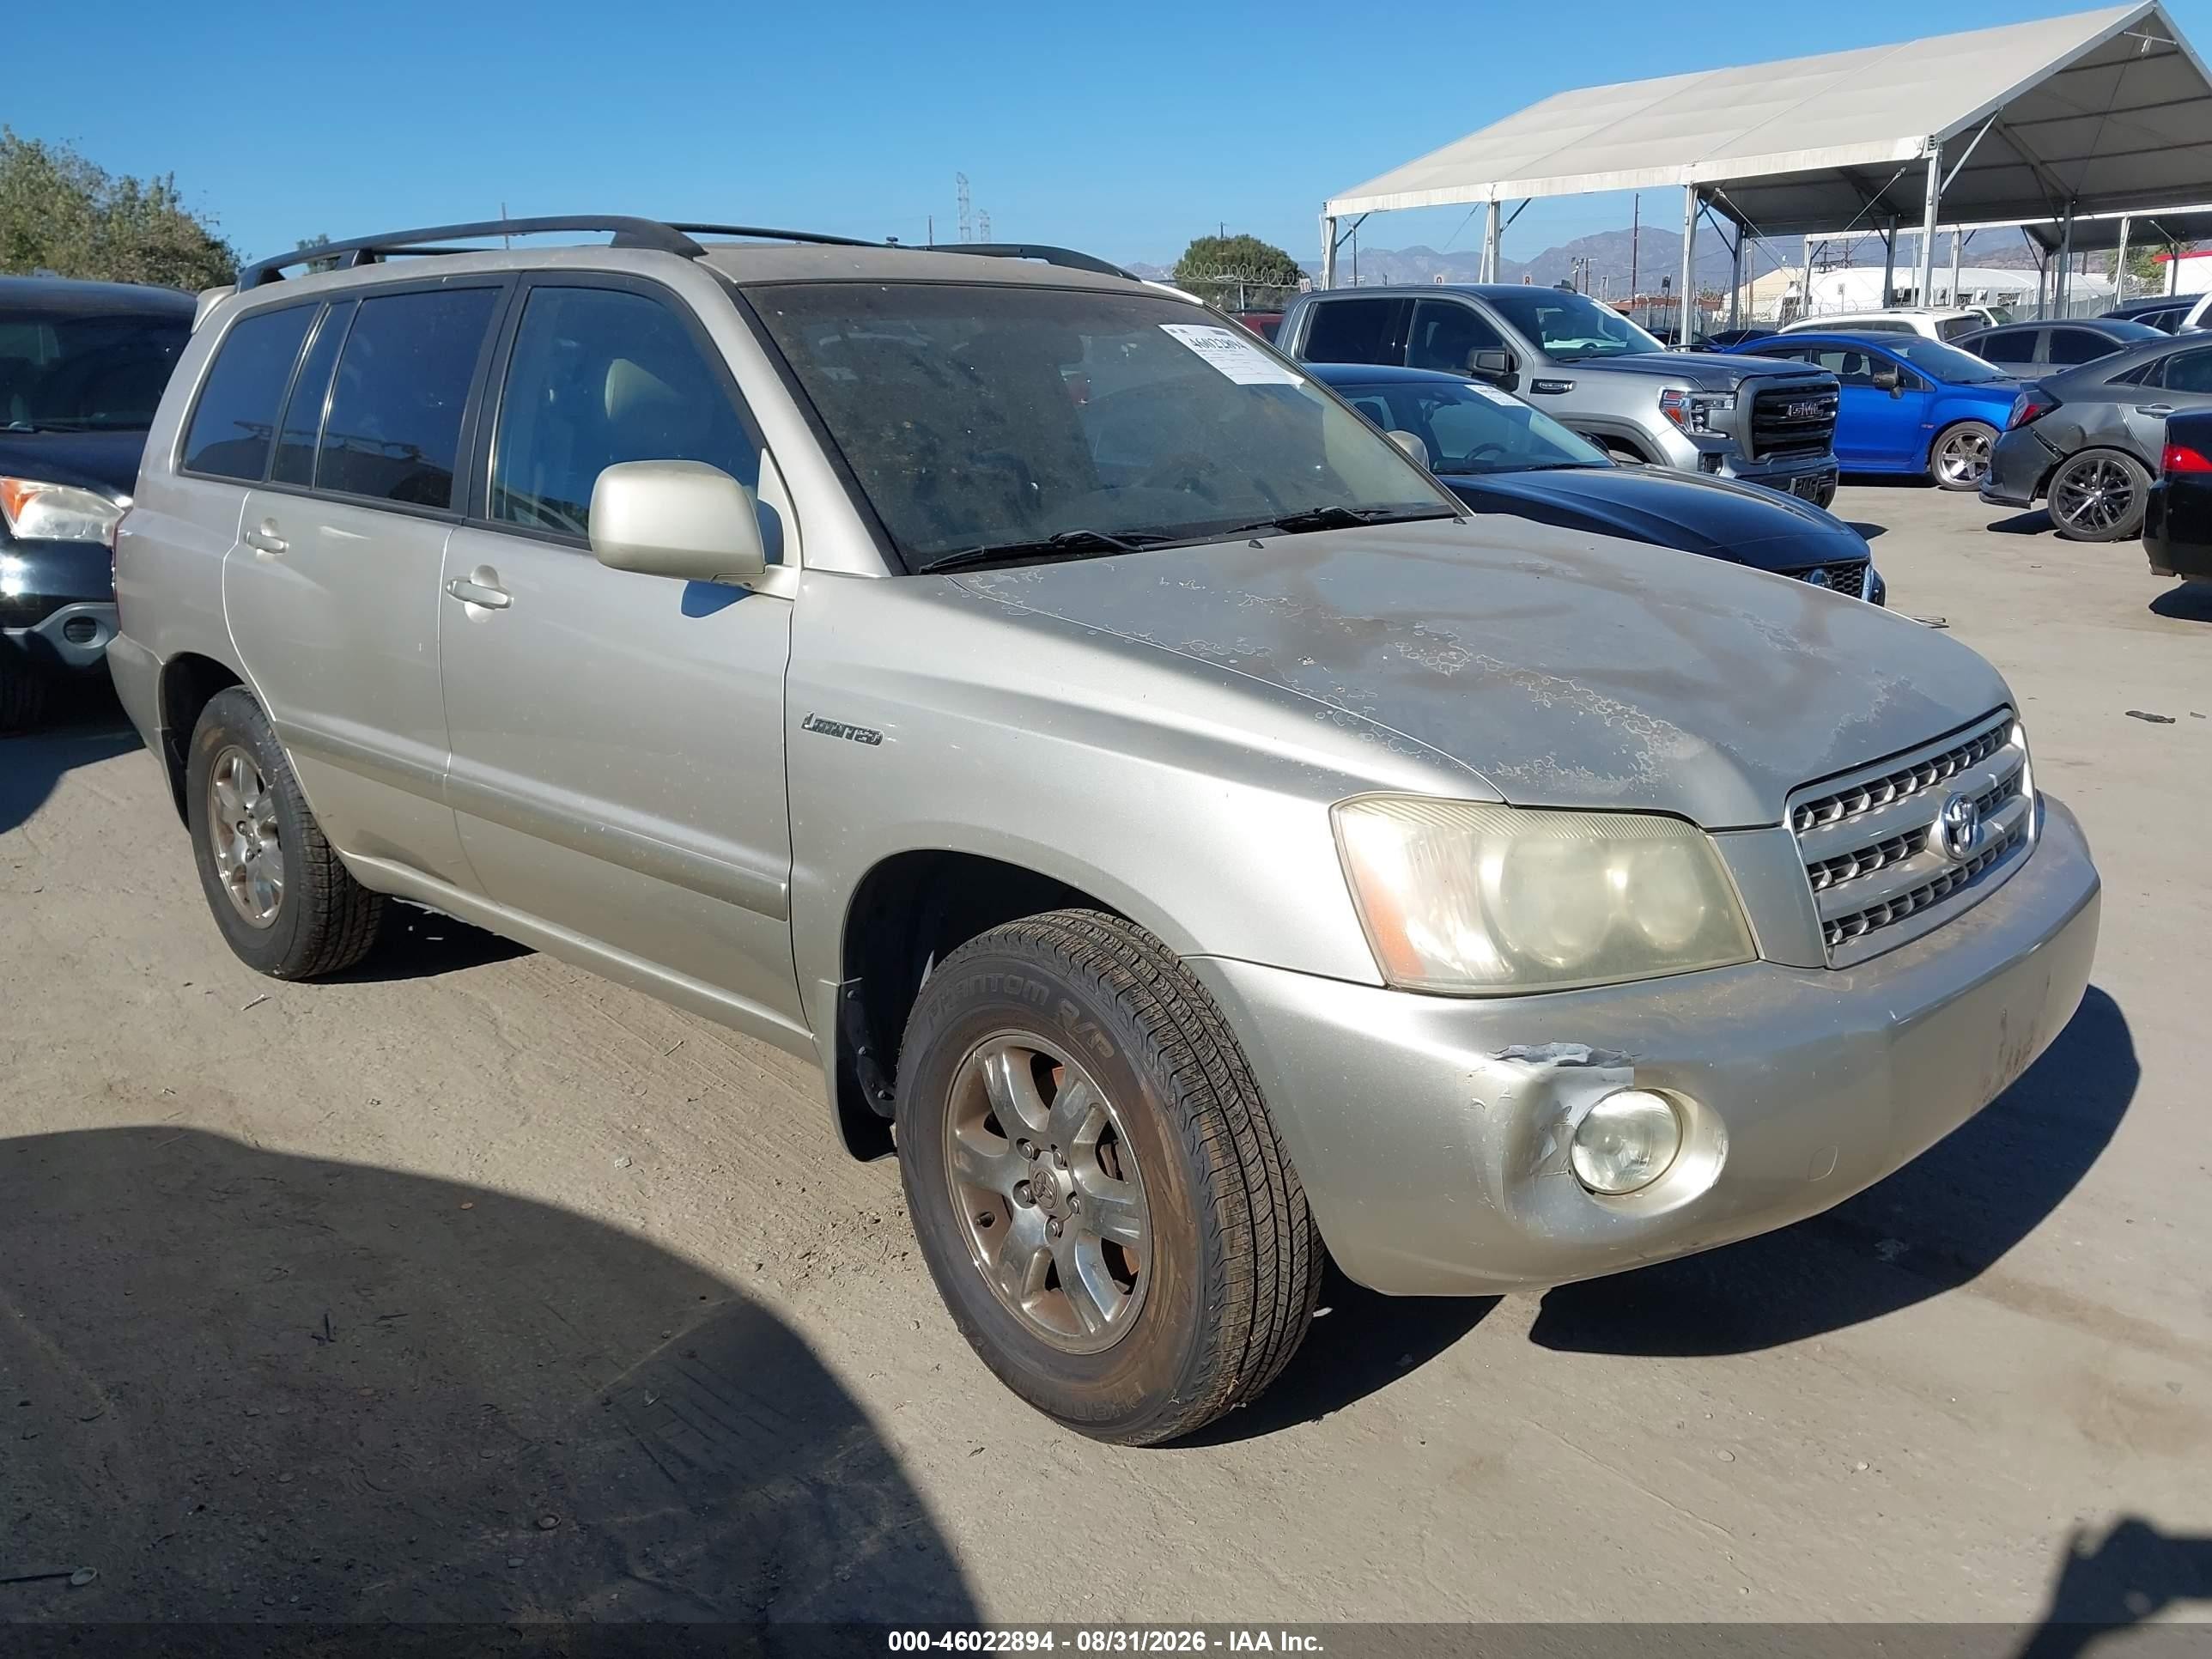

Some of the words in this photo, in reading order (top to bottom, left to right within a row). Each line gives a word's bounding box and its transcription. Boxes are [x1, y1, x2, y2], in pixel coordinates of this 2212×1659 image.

[1300, 282, 1311, 292] 10
[1789, 402, 1824, 416] GMC
[801, 712, 882, 747] LIMITED
